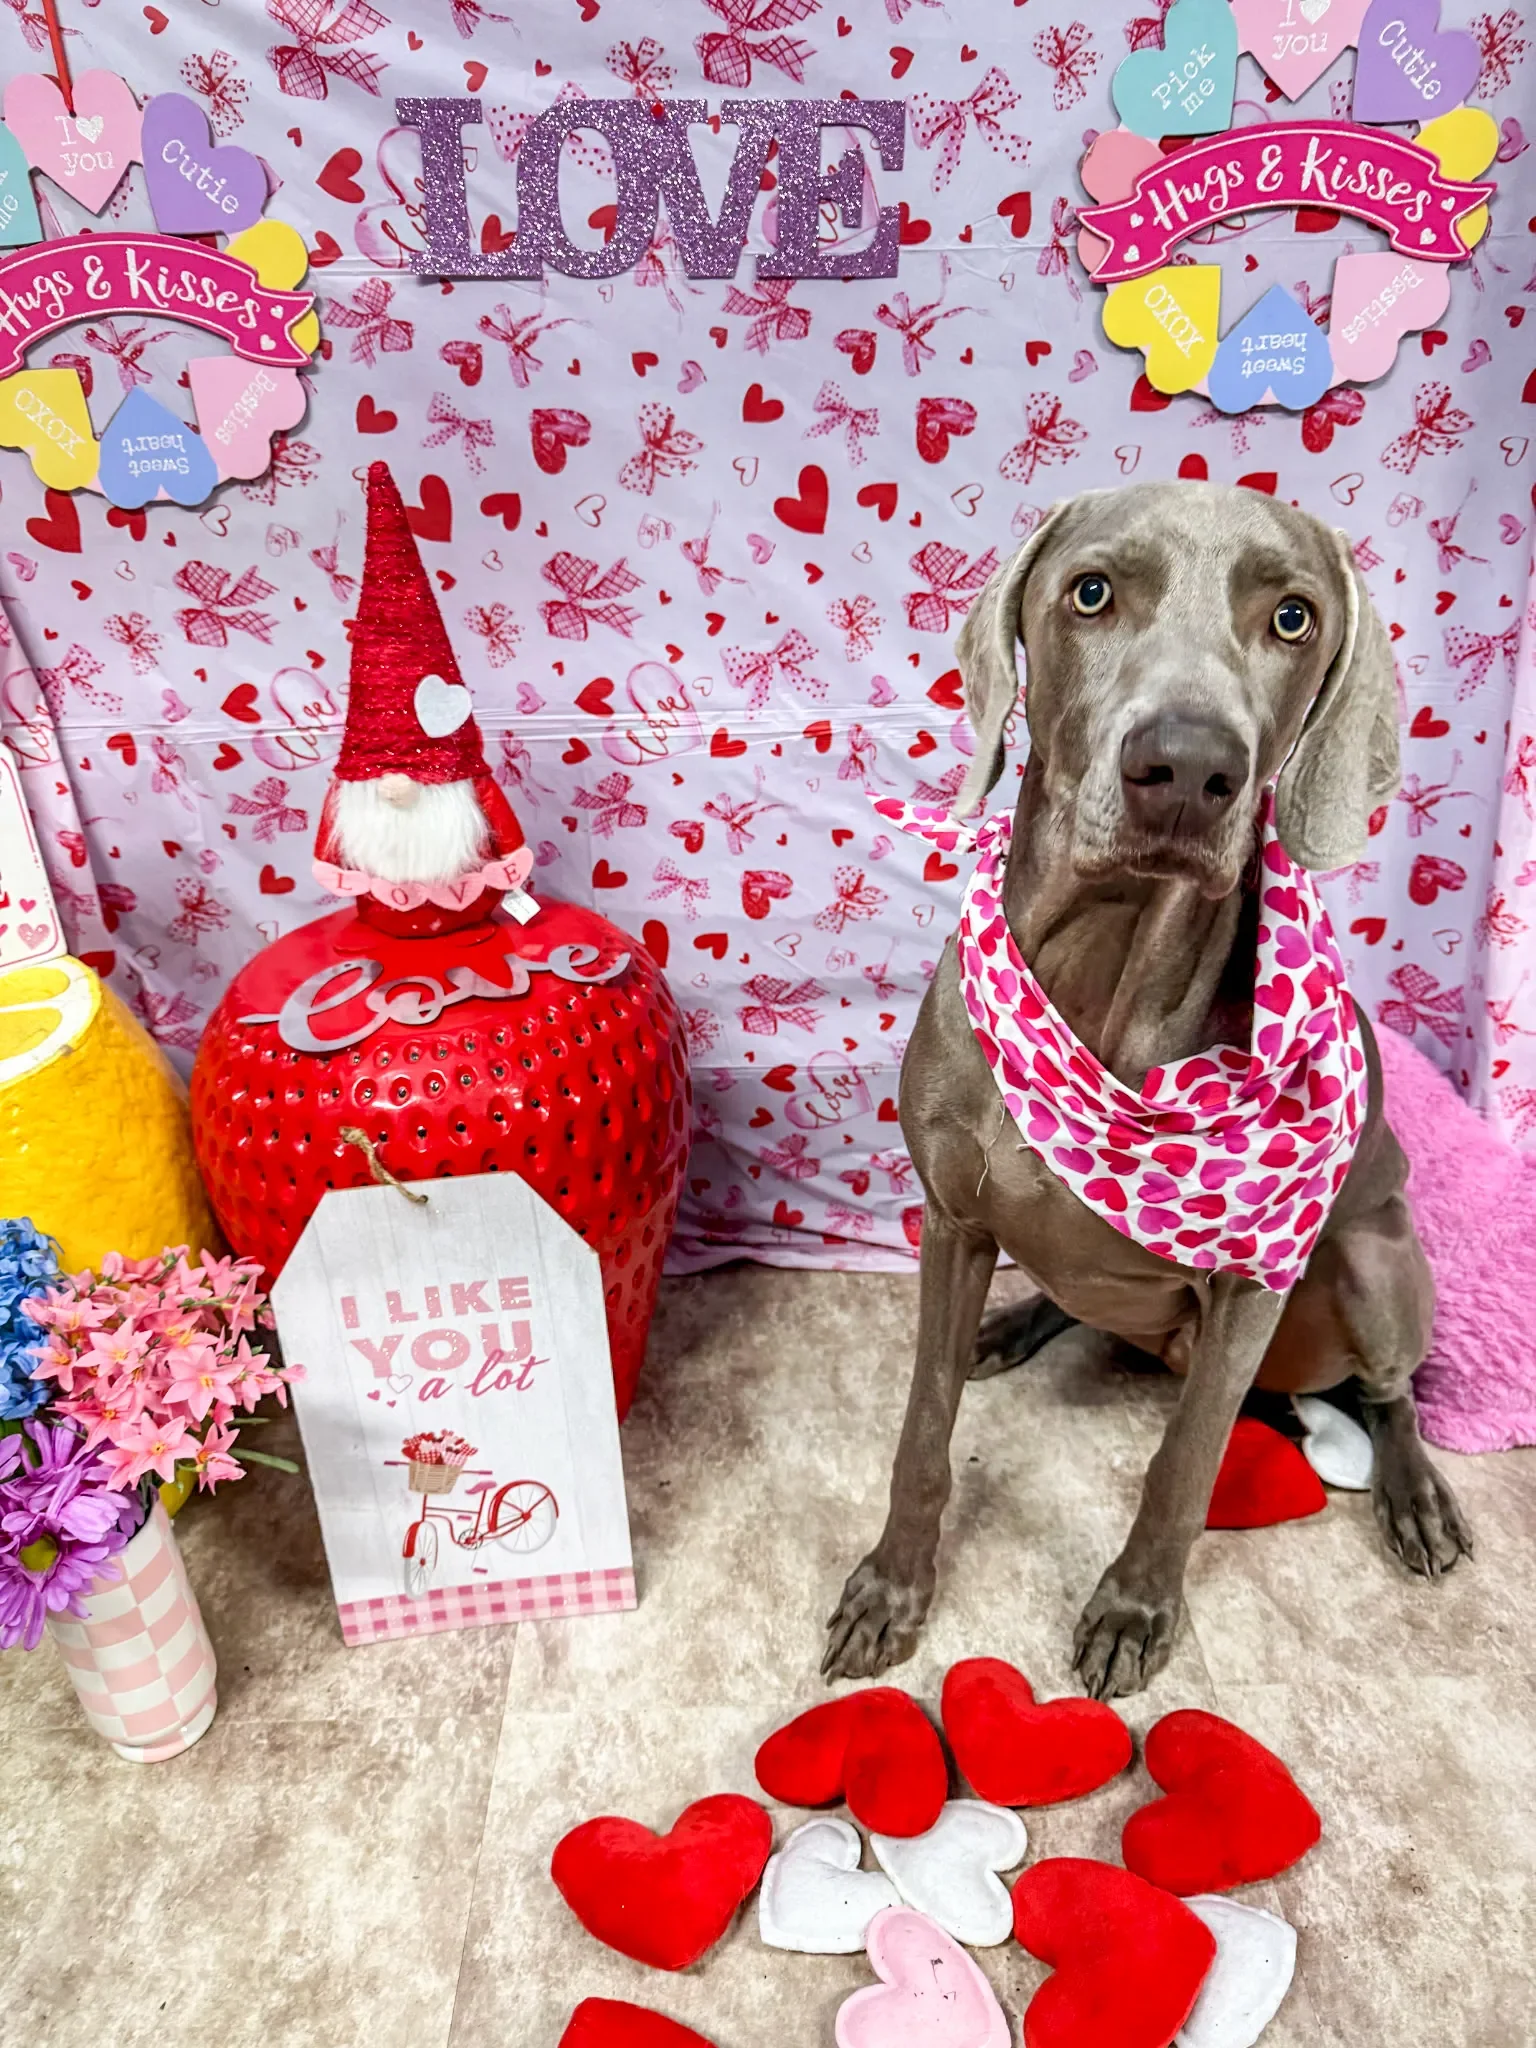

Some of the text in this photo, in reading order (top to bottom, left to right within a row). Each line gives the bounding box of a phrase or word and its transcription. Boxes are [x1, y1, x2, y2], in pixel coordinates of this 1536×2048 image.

[1271, 32, 1328, 60] you
[1379, 19, 1442, 100] Cutie
[1151, 43, 1216, 111] Pick
[1181, 78, 1216, 116] me
[54, 115, 78, 146] I
[59, 151, 116, 177] you
[161, 139, 239, 214] Cutie
[395, 97, 905, 280] LOVE
[1148, 160, 1244, 231] Hugs
[1256, 144, 1284, 192] &
[1300, 136, 1431, 223] Kisses
[0, 247, 261, 337] Hugs & Kisses
[1341, 263, 1425, 345] Besties
[1144, 284, 1206, 360] XOXO
[1240, 332, 1308, 357] heart
[1240, 356, 1306, 379] Sweet
[15, 387, 87, 460] XOXO
[214, 368, 278, 446] Besties
[121, 434, 187, 457] heart
[128, 457, 190, 479] Sweet
[336, 863, 521, 906] LOVE
[340, 1275, 533, 1329] I LIKE
[350, 1319, 534, 1379] YOU
[417, 1348, 551, 1402] a lot
